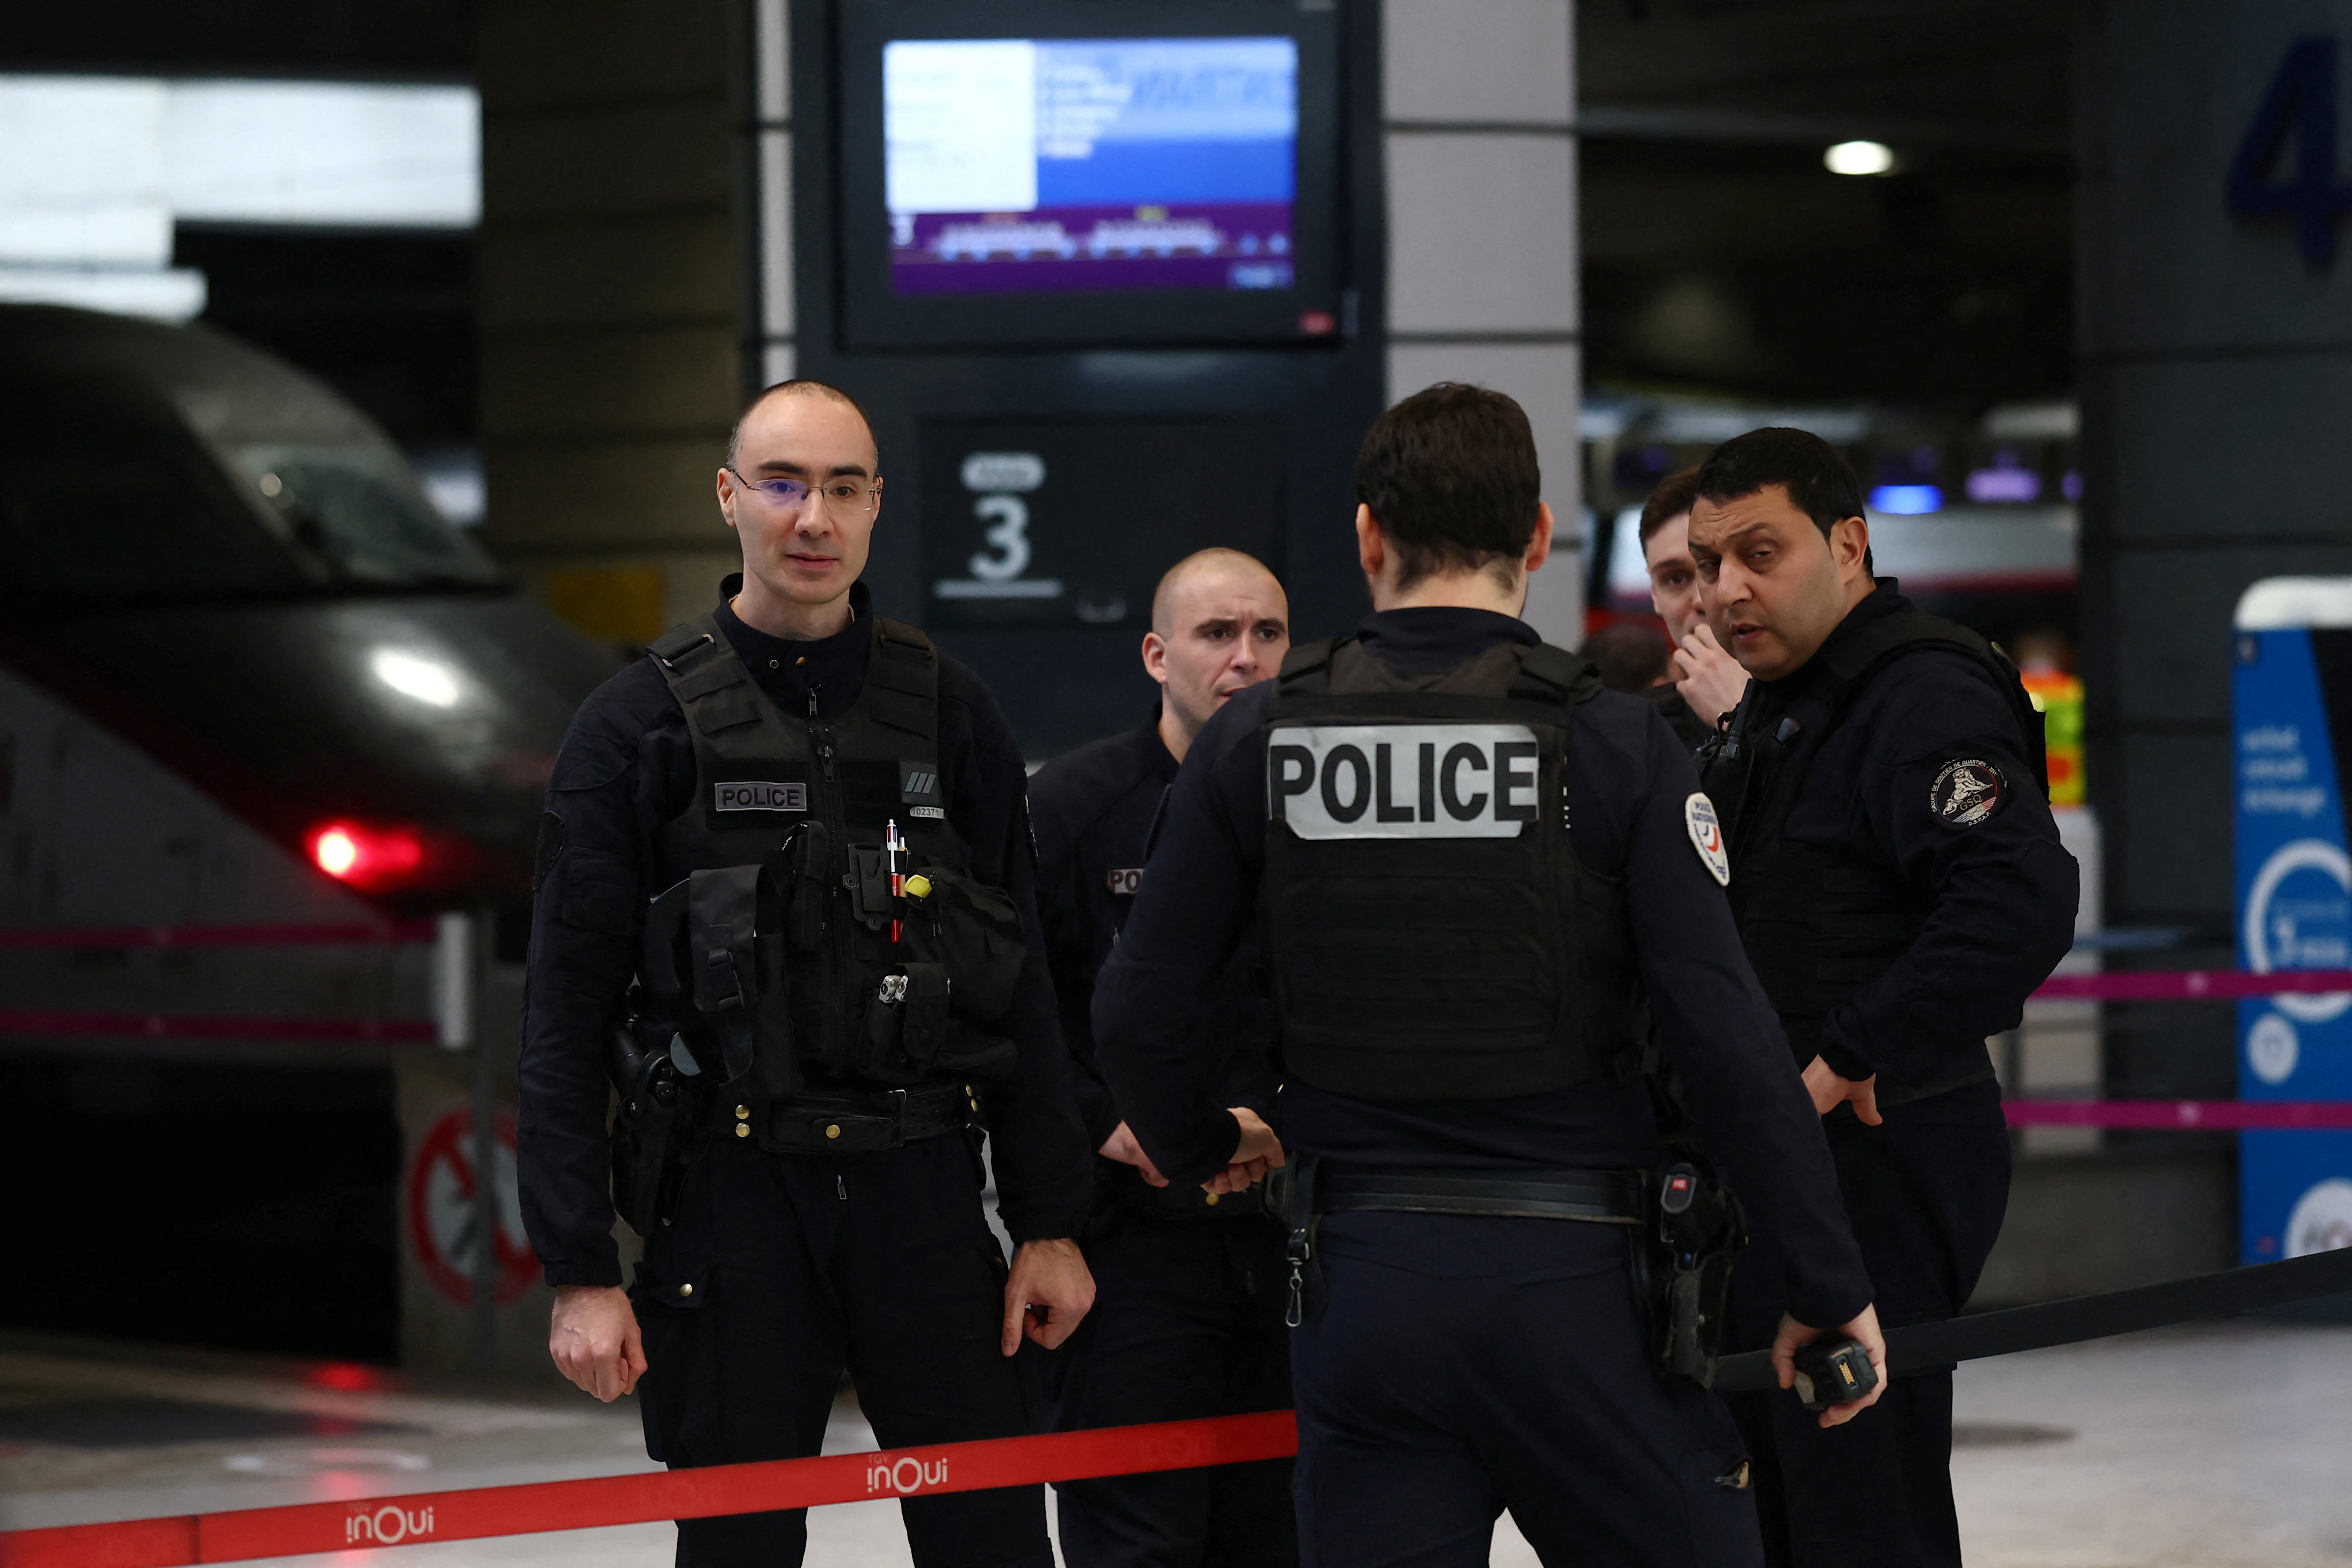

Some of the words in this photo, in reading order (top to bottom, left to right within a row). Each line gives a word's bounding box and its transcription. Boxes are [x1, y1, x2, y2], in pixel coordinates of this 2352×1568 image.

[2224, 34, 2352, 264] 4
[970, 495, 1030, 579] 3
[722, 788, 800, 807] POLICE
[1270, 741, 1538, 824] POLICE
[1935, 765, 1953, 784] SOUTIEN
[1961, 759, 1987, 767] QUARTIER
[1960, 794, 1983, 810] GSQ
